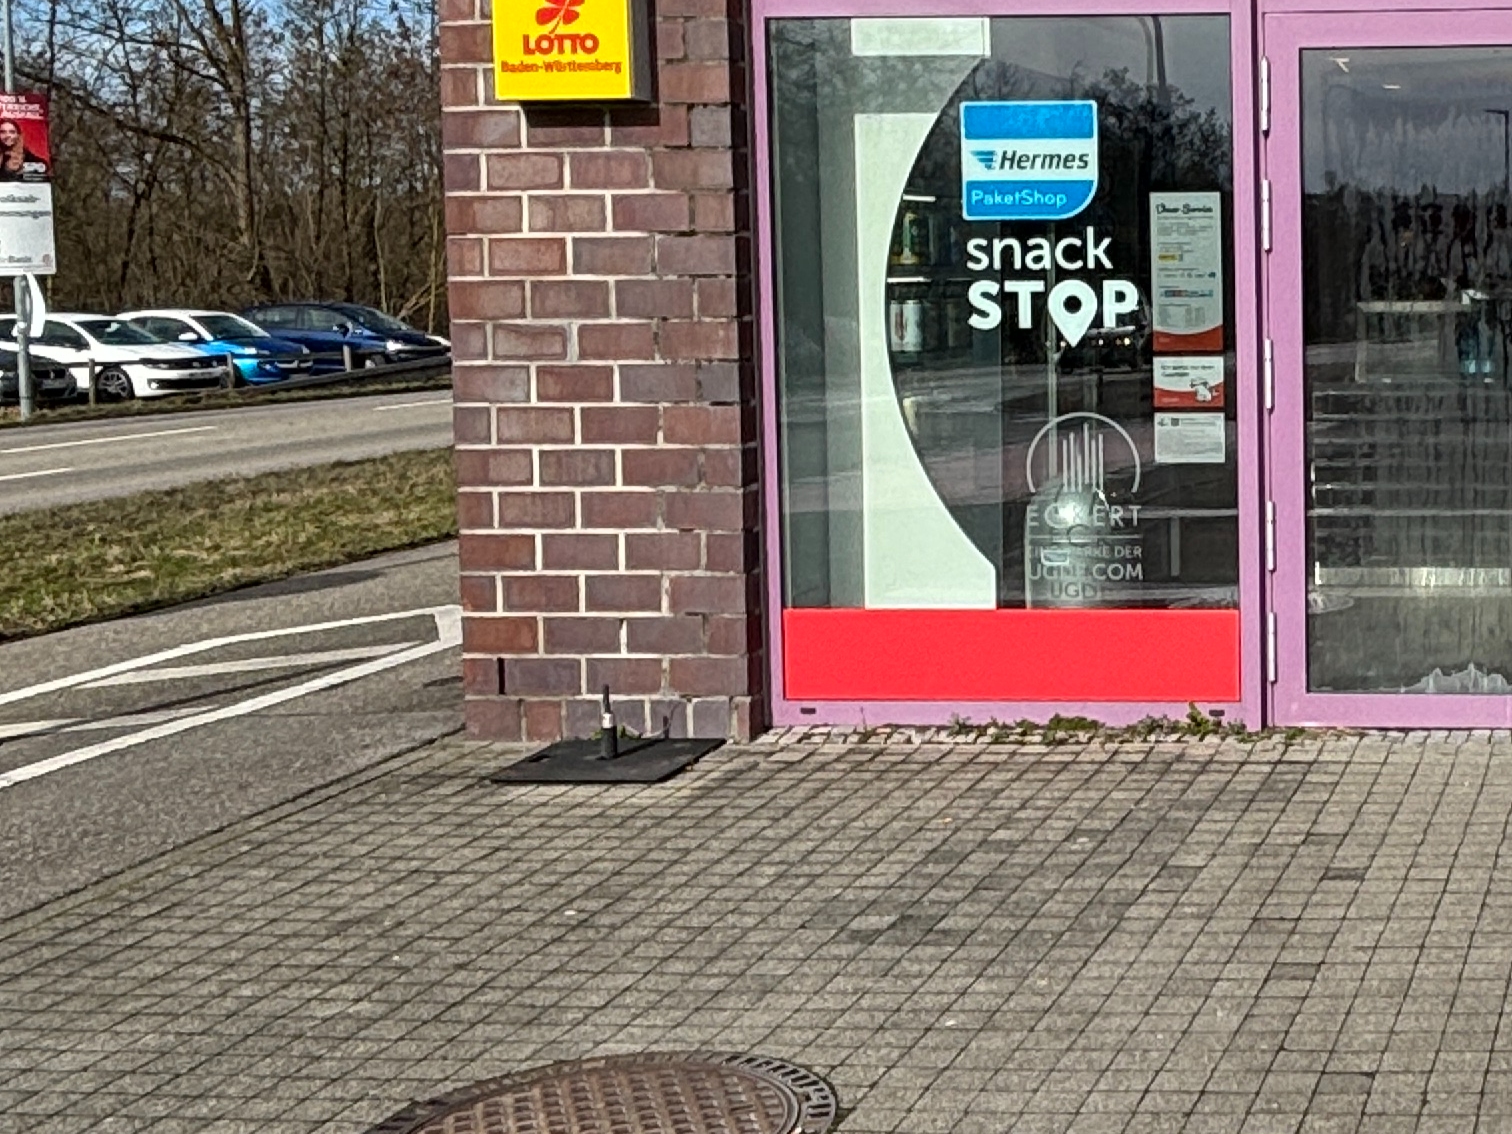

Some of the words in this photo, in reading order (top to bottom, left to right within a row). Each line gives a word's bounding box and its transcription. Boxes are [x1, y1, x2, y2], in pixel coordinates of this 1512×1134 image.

[522, 33, 600, 56] LOTTO
[500, 59, 622, 75] Baden-Württemberg
[999, 150, 1090, 171] Hermes
[970, 189, 1068, 208] PaketShop
[965, 225, 1115, 271] snack
[966, 278, 1141, 348] STOP
[1027, 503, 1142, 529] ECERT
[1114, 545, 1142, 560] DER
